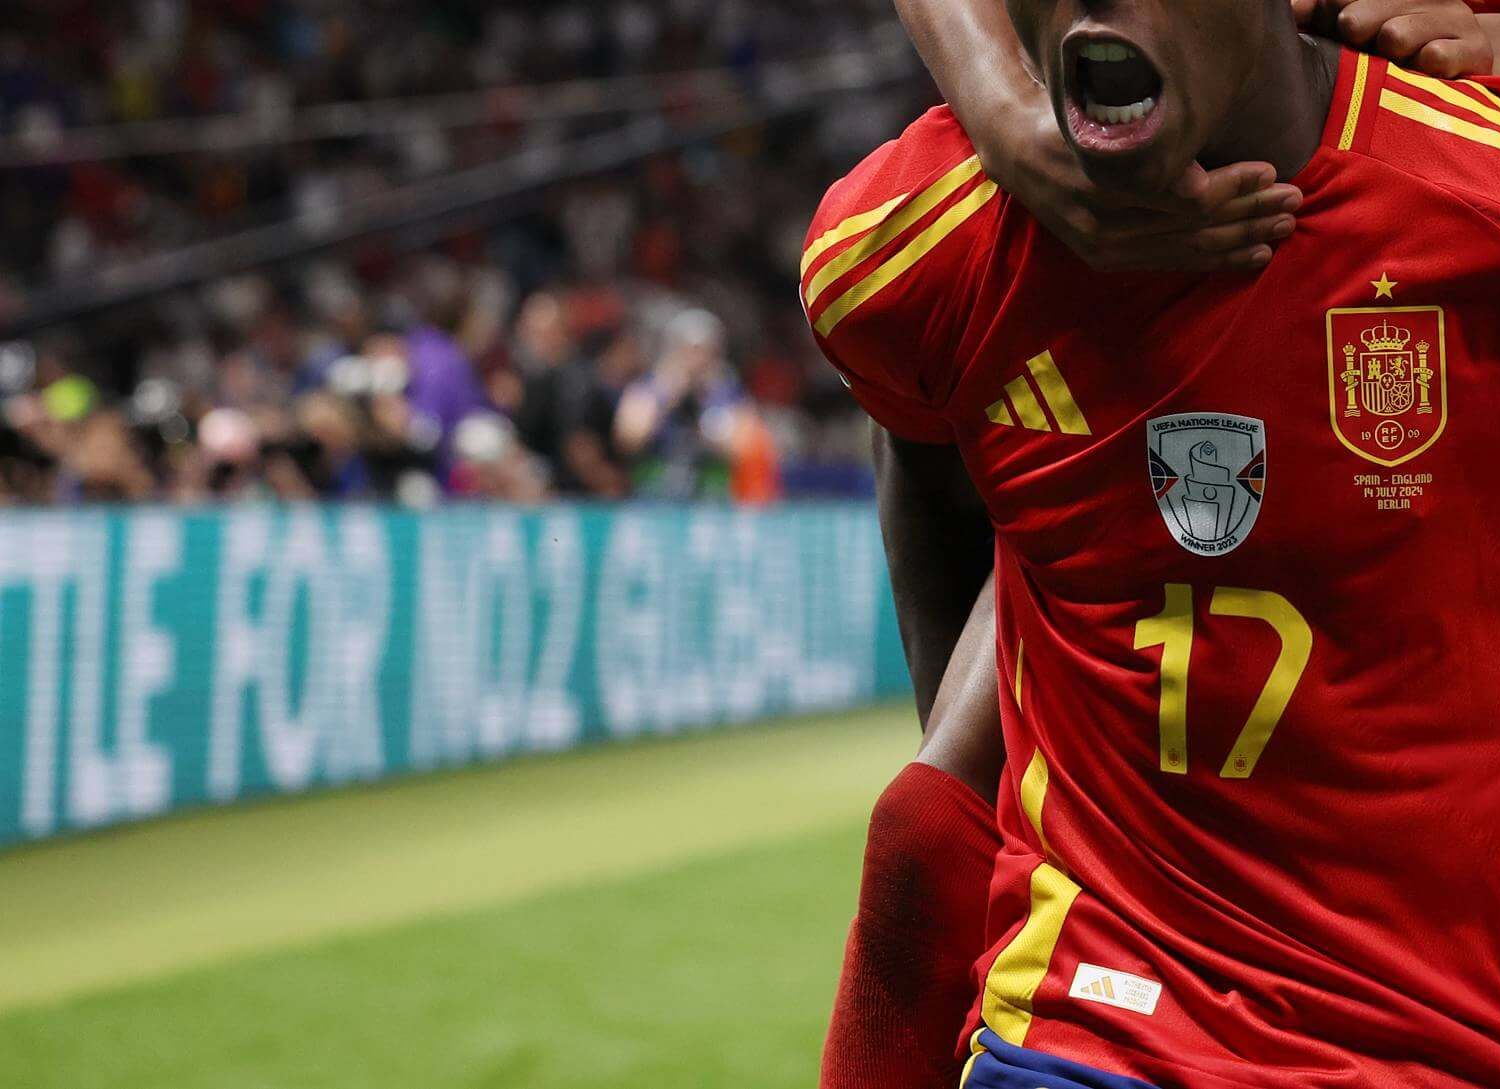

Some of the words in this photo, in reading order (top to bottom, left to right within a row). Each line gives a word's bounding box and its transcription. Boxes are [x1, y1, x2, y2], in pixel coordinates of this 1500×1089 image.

[1152, 421, 1177, 432] UEFA
[1178, 418, 1220, 428] NATIONS
[1221, 419, 1259, 432] LEAGUE
[1354, 474, 1380, 486] SPAIN
[1391, 473, 1433, 485] ENGLAND
[1364, 487, 1374, 498] 14
[1375, 487, 1397, 498] JULY
[1399, 486, 1424, 497] 2024
[1377, 499, 1411, 510] BERLIN
[1181, 534, 1216, 552] WINNER
[1216, 535, 1238, 551] 2023
[1132, 583, 1314, 779] 17
